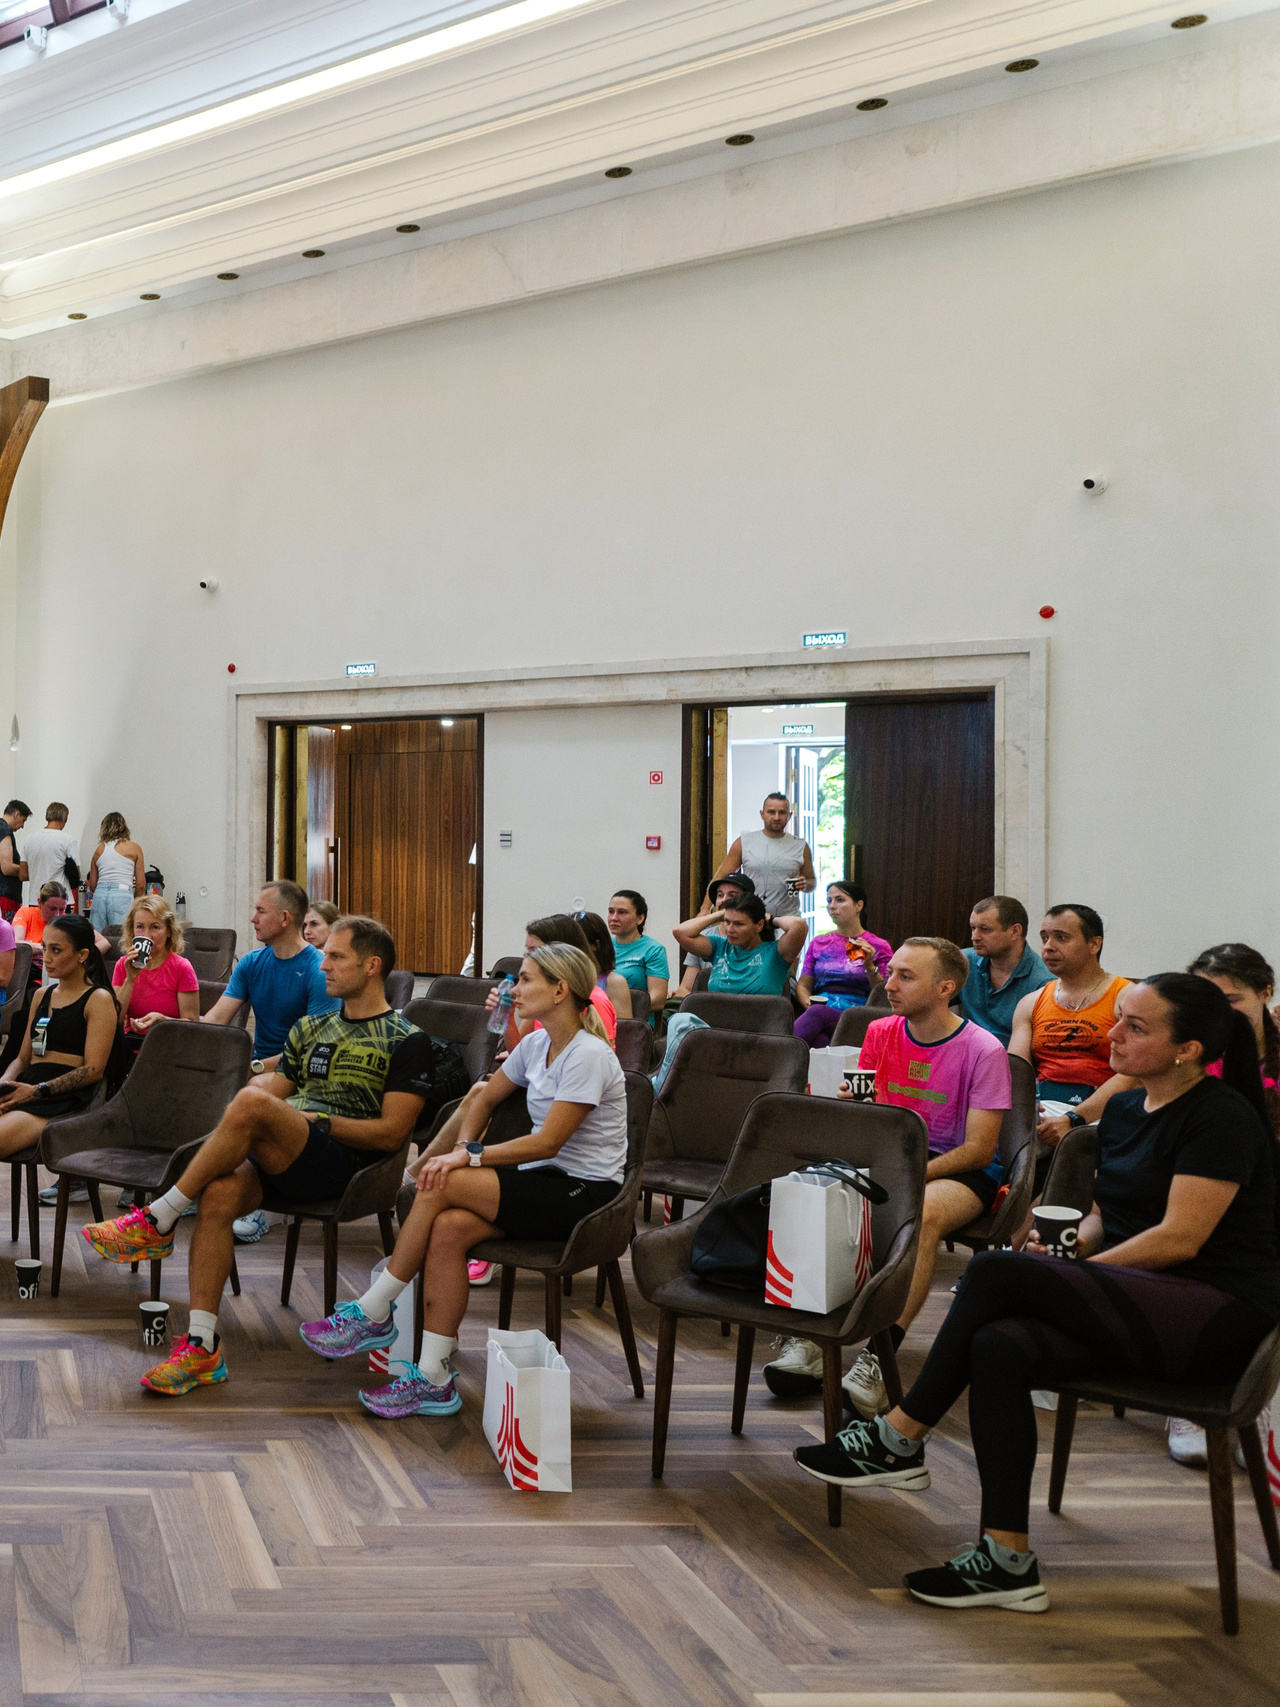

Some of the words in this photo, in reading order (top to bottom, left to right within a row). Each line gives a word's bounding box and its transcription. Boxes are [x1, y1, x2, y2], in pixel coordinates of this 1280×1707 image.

[805, 634, 845, 646] ВЫХОД
[347, 664, 374, 675] ВЫХОД
[784, 726, 813, 734] ВЫХОД
[1044, 1019, 1079, 1032] GOLDEN
[1080, 1019, 1099, 1032] RING
[309, 1063, 327, 1074] STAR
[144, 1328, 166, 1346] fix
